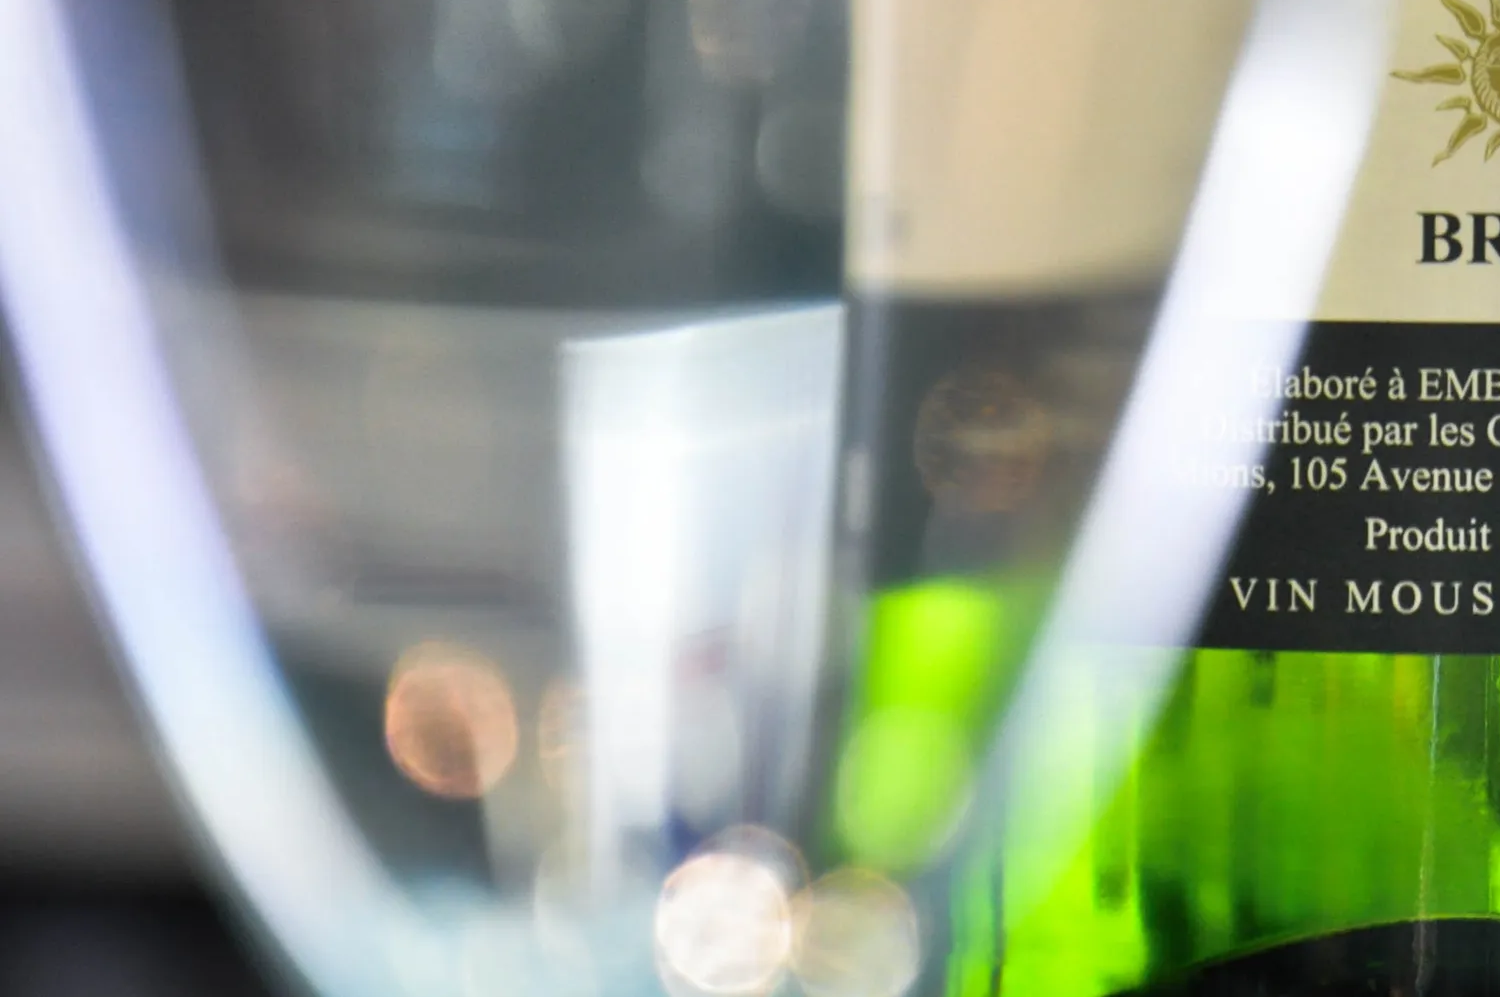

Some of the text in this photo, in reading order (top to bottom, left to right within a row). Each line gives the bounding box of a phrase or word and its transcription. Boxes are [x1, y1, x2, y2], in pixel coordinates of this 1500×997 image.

[1387, 367, 1407, 400] à
[1362, 421, 1419, 455] par
[1429, 412, 1476, 447] les
[1292, 456, 1347, 491] 105
[1360, 458, 1494, 493] Avenue
[1366, 517, 1491, 552] Produit
[1230, 577, 1317, 612] VIN
